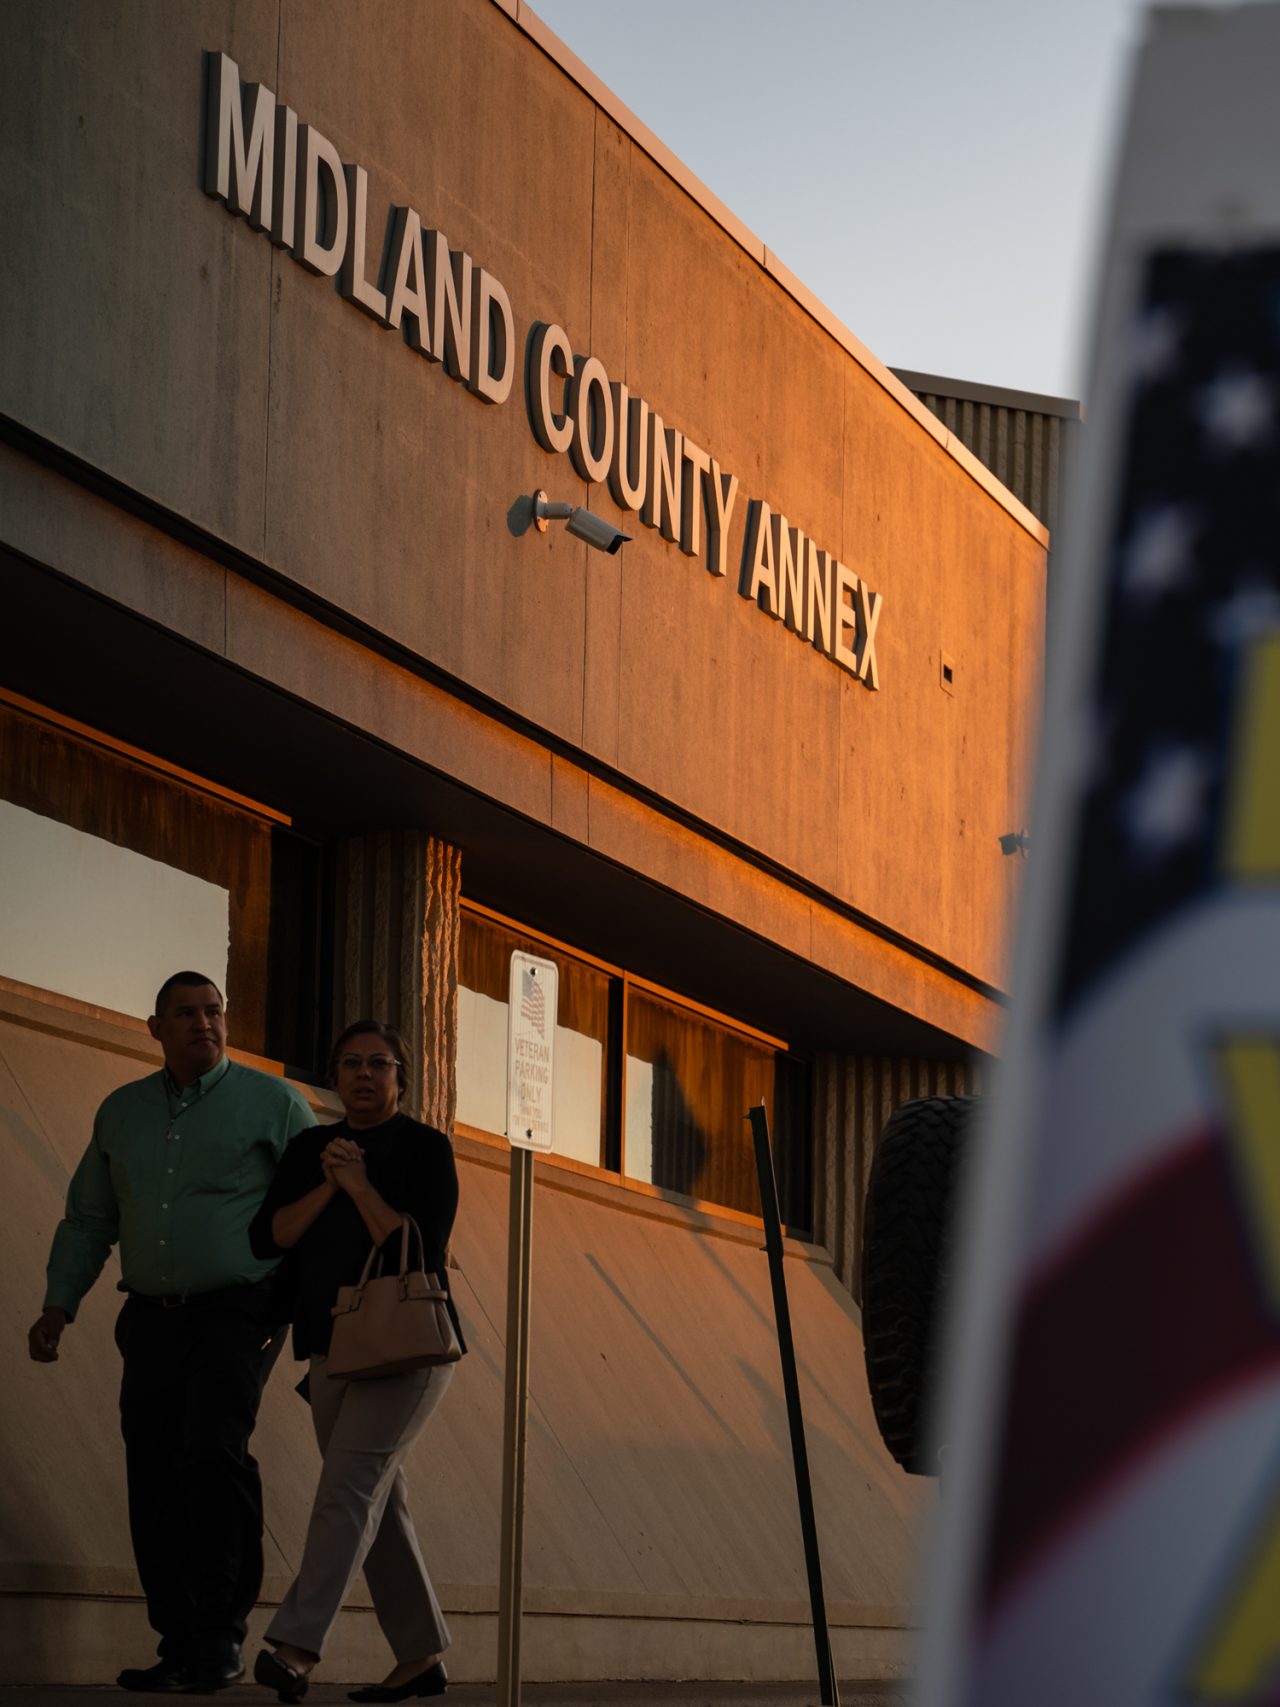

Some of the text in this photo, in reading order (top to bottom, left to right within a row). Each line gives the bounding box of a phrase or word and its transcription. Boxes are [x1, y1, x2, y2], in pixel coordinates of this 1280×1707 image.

[206, 51, 883, 691] MIDLAND COUNTY ANNEX
[514, 1038, 549, 1062] VETERAN
[514, 1060, 548, 1084] PARKING
[519, 1082, 541, 1103] ONLY
